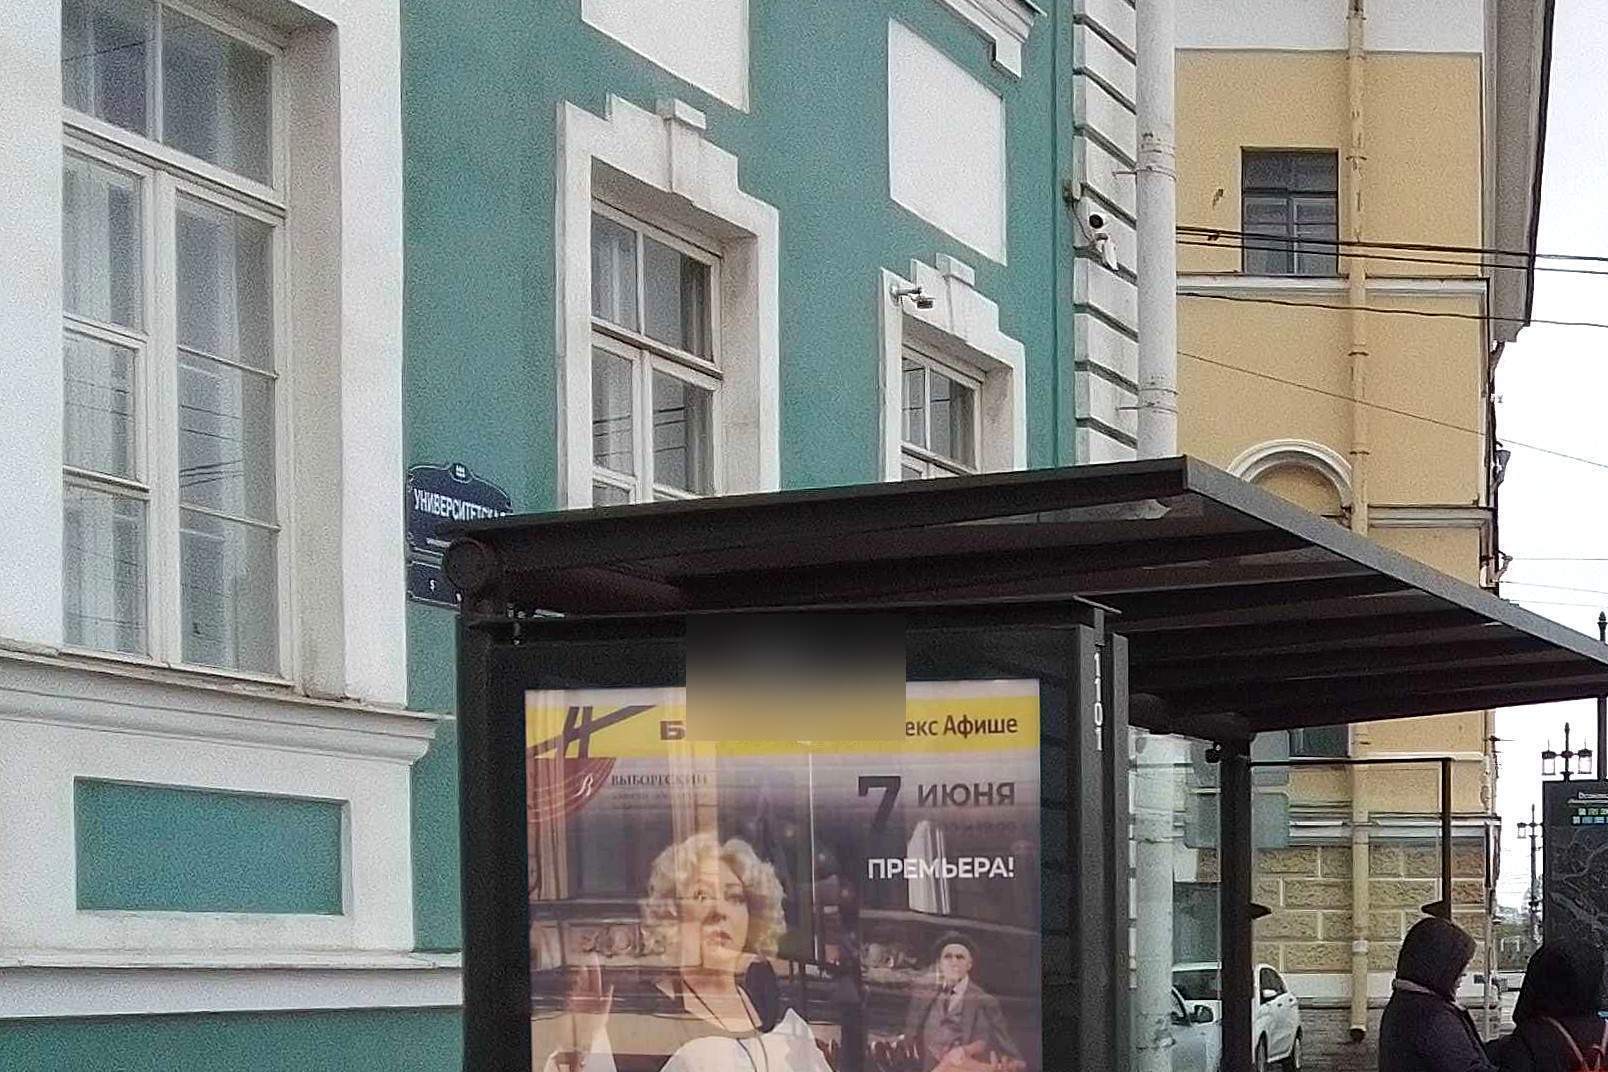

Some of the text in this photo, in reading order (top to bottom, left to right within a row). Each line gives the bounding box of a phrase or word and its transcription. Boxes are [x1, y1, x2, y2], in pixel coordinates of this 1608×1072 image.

[943, 714, 1018, 736] Афише
[858, 775, 902, 834] 7
[867, 856, 1015, 880] ПРЕМЬЕРА!
